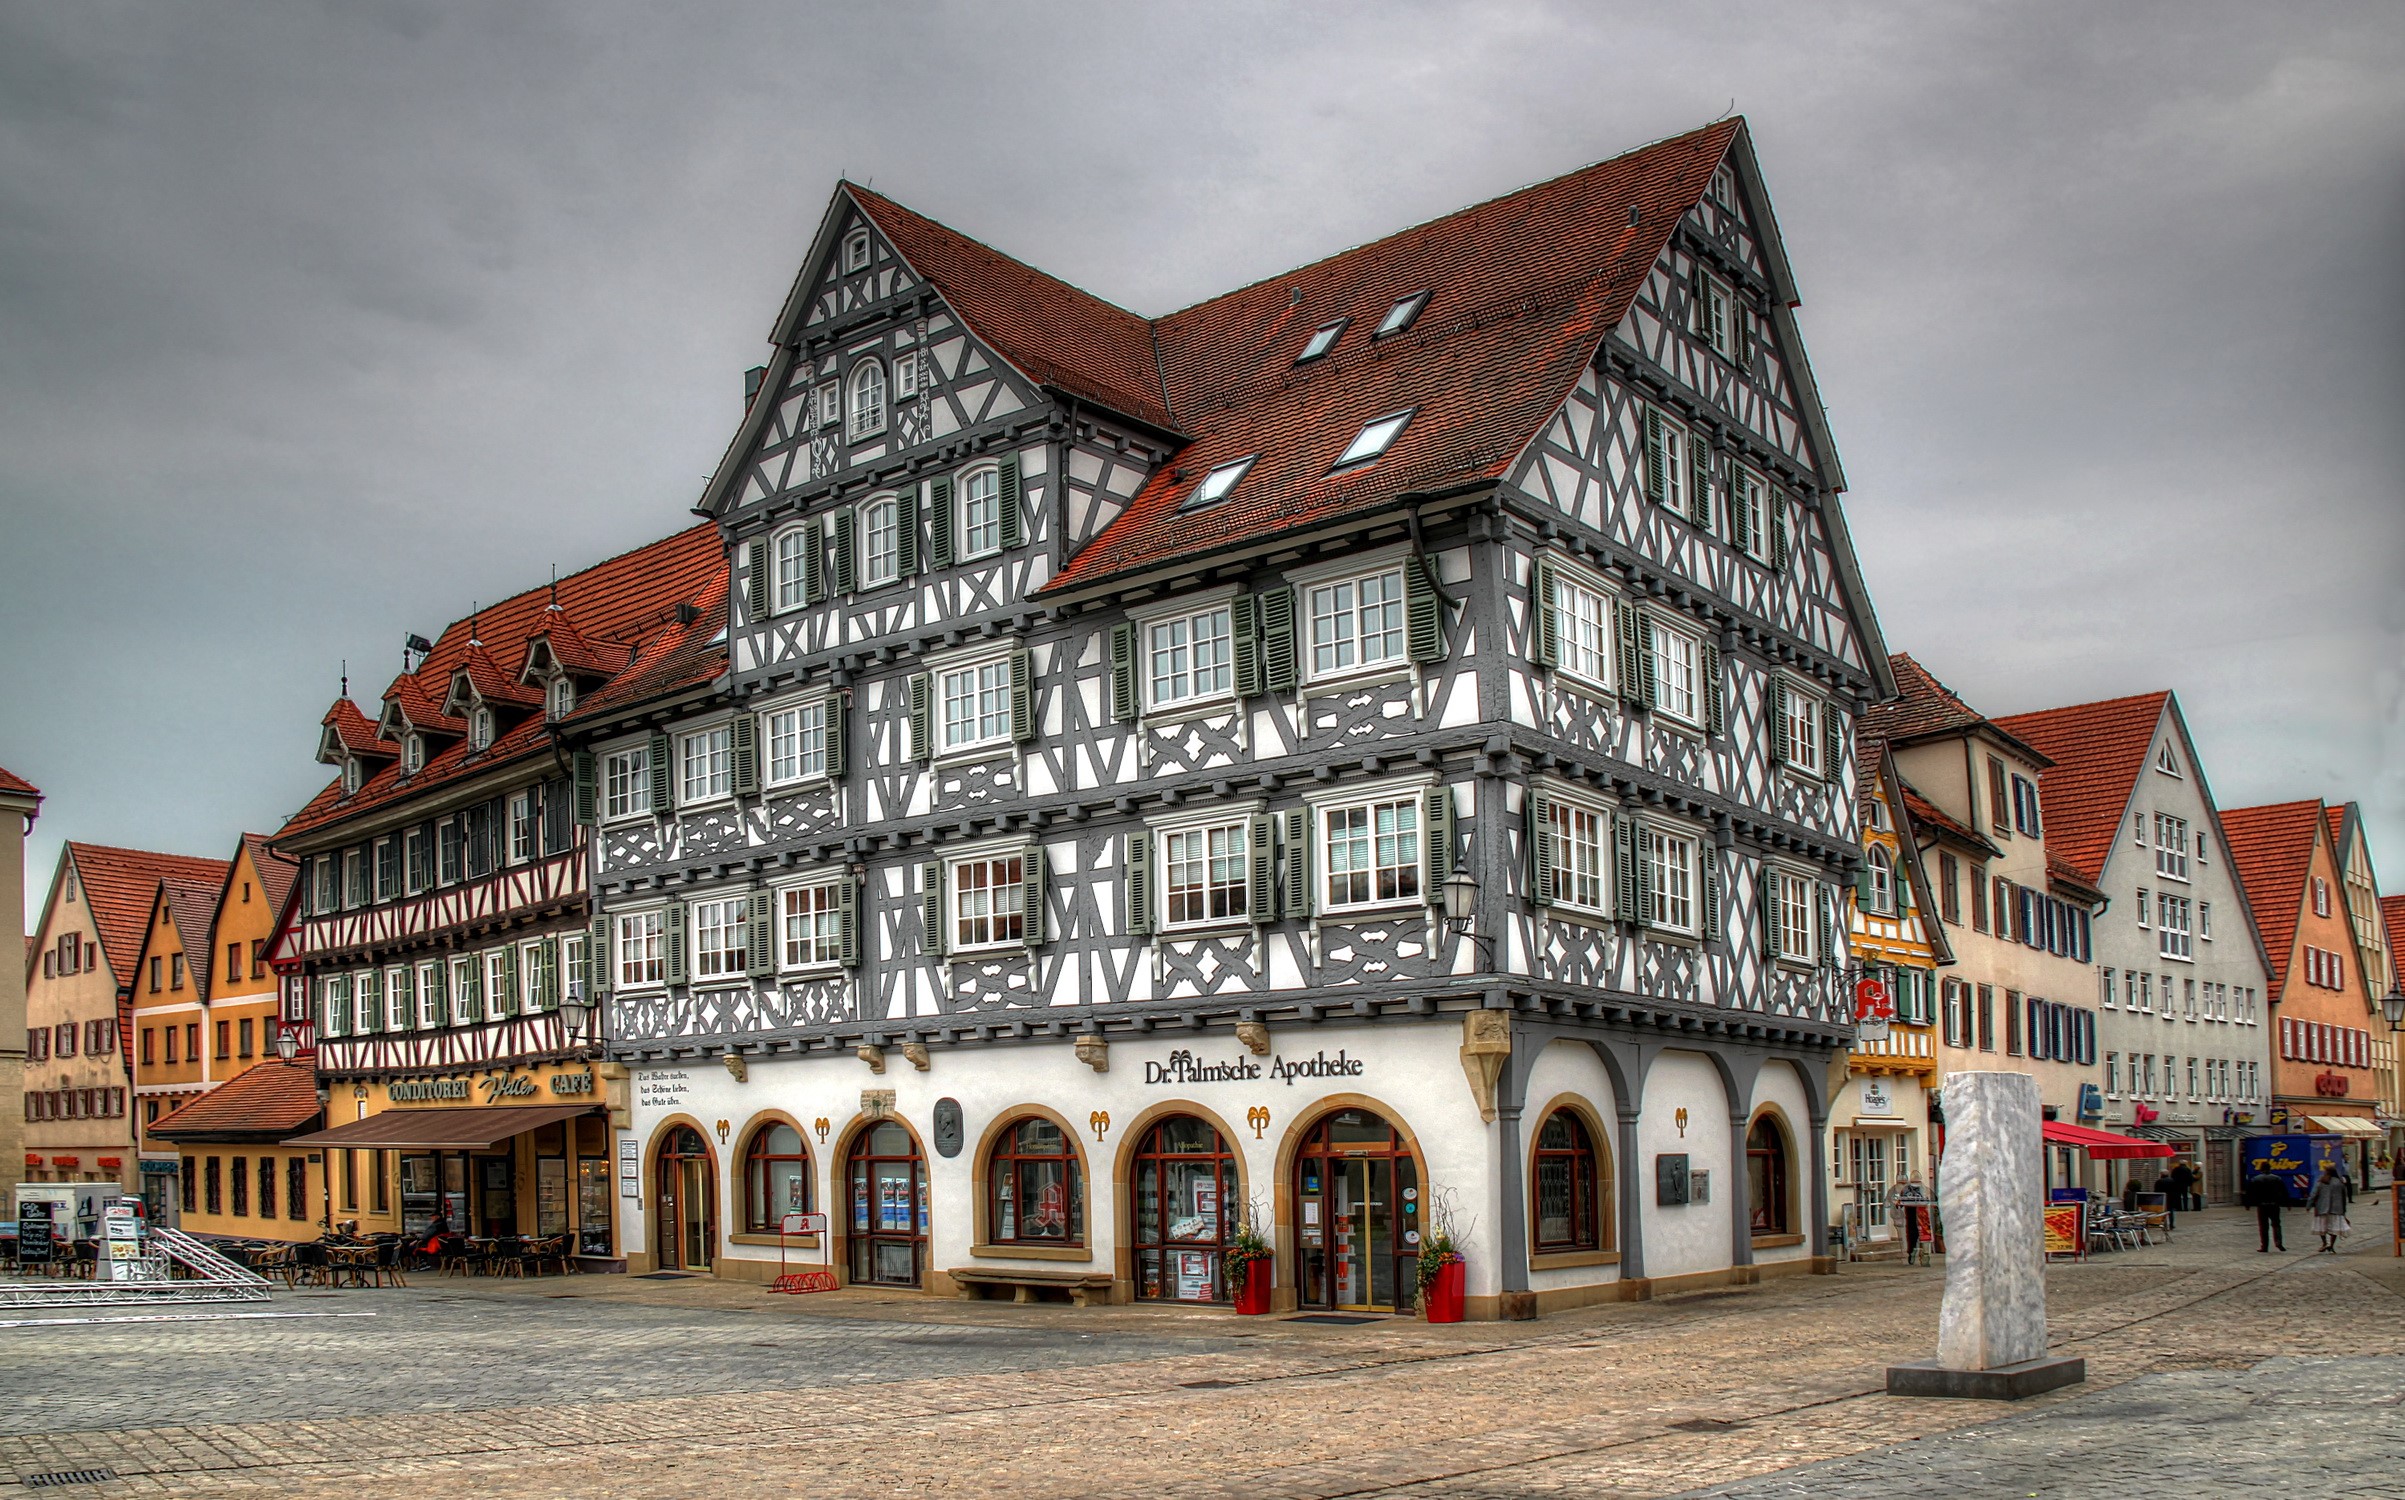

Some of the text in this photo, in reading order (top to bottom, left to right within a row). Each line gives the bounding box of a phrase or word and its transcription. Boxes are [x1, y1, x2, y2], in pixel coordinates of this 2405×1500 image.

[388, 1080, 469, 1101] CONDITOREI
[550, 1066, 593, 1094] CAFÉ
[1145, 1061, 1172, 1084] Dr.
[1269, 1049, 1363, 1085] Apotheke
